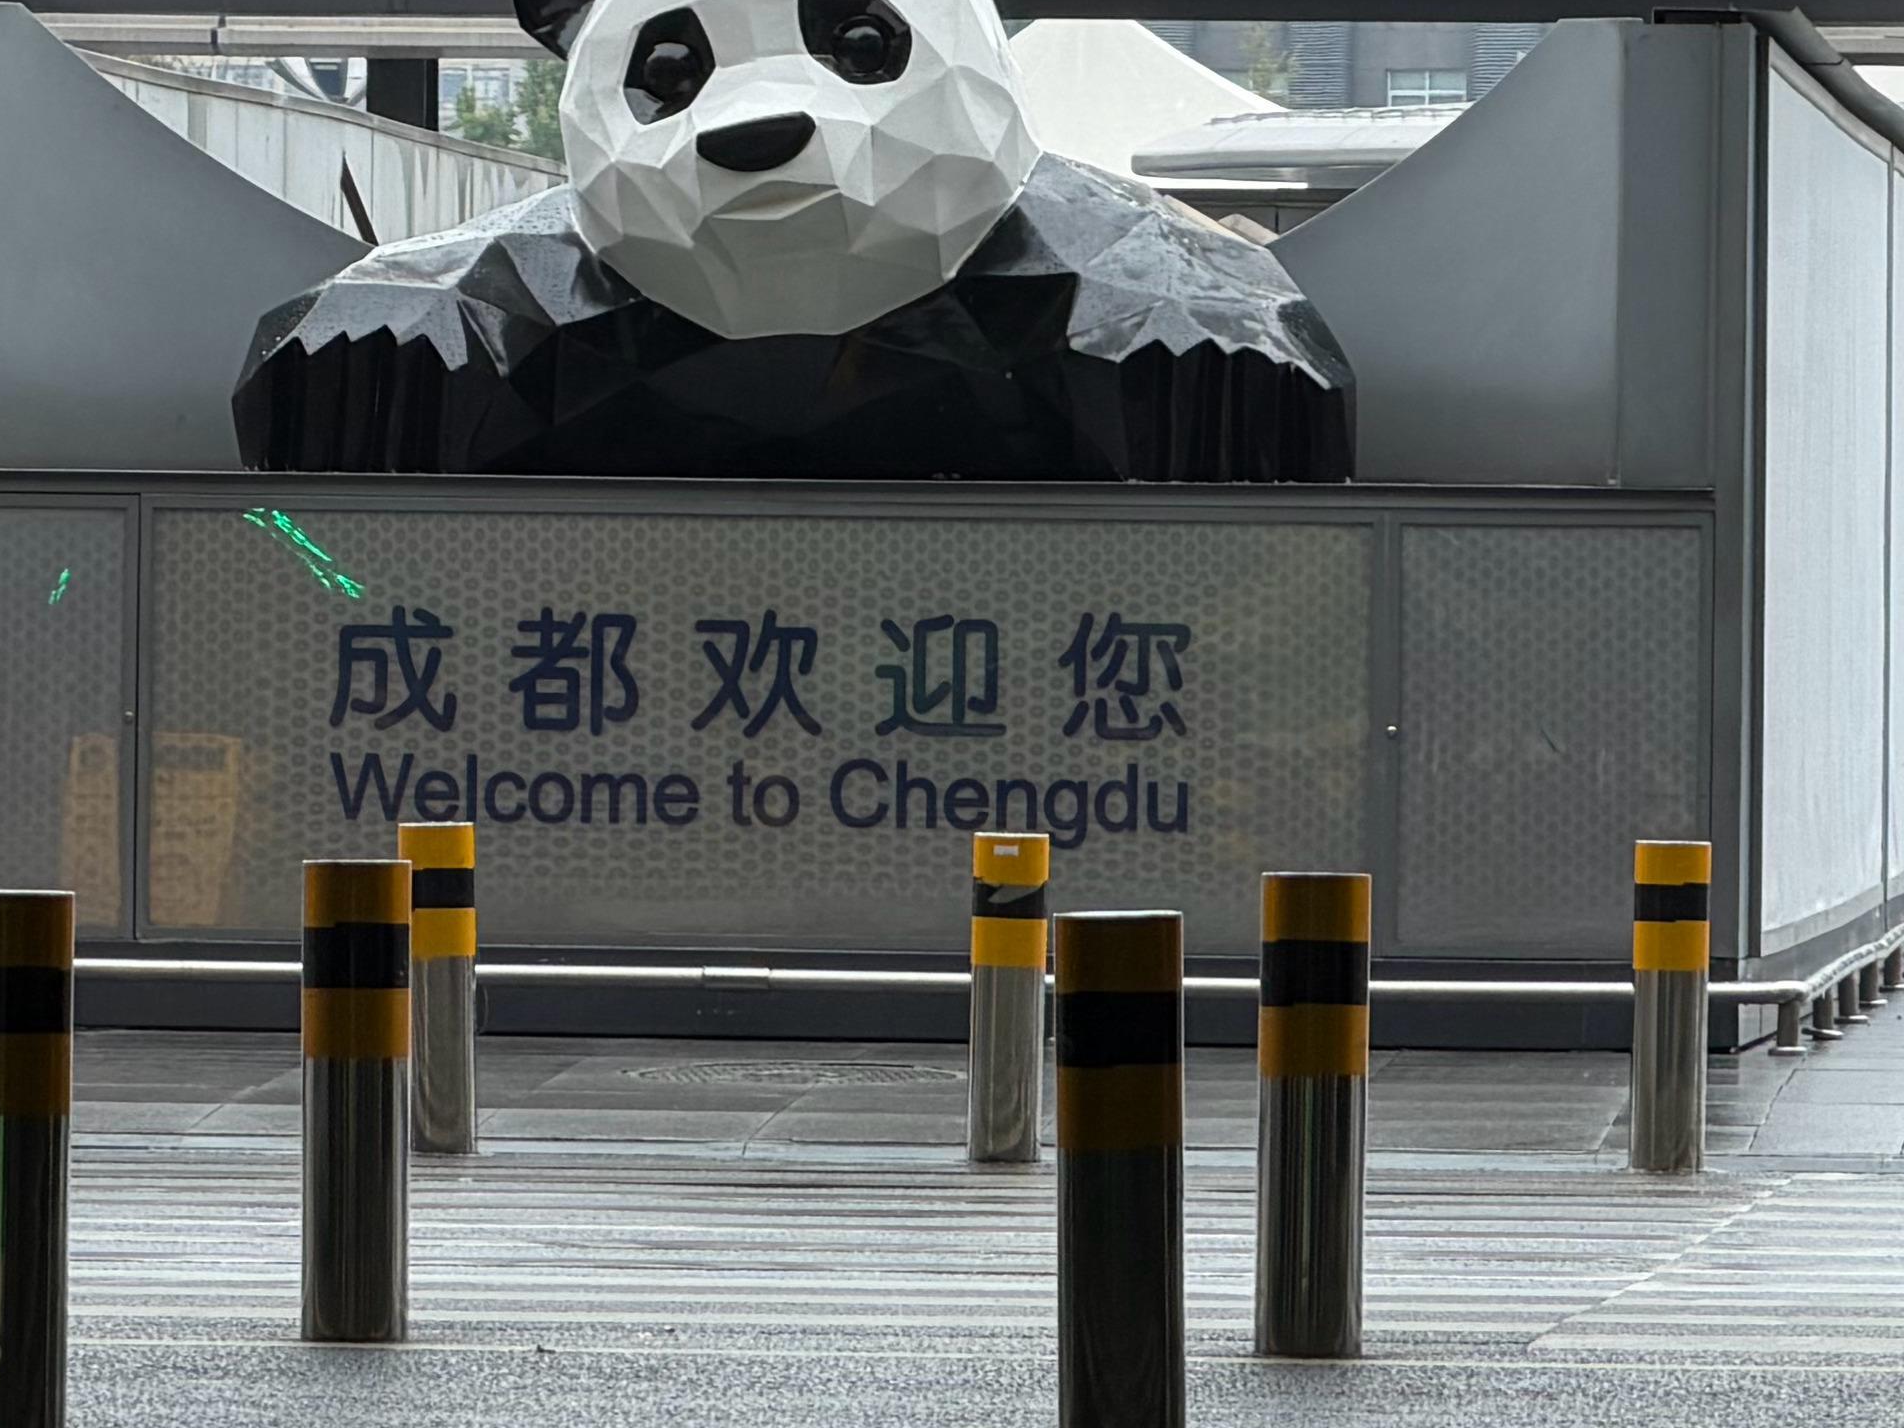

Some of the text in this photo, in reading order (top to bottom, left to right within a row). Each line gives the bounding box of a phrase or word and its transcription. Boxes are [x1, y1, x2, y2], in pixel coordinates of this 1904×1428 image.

[329, 604, 1192, 742] 成都欢迎您
[329, 751, 1190, 851] Welcome to Chengdu
